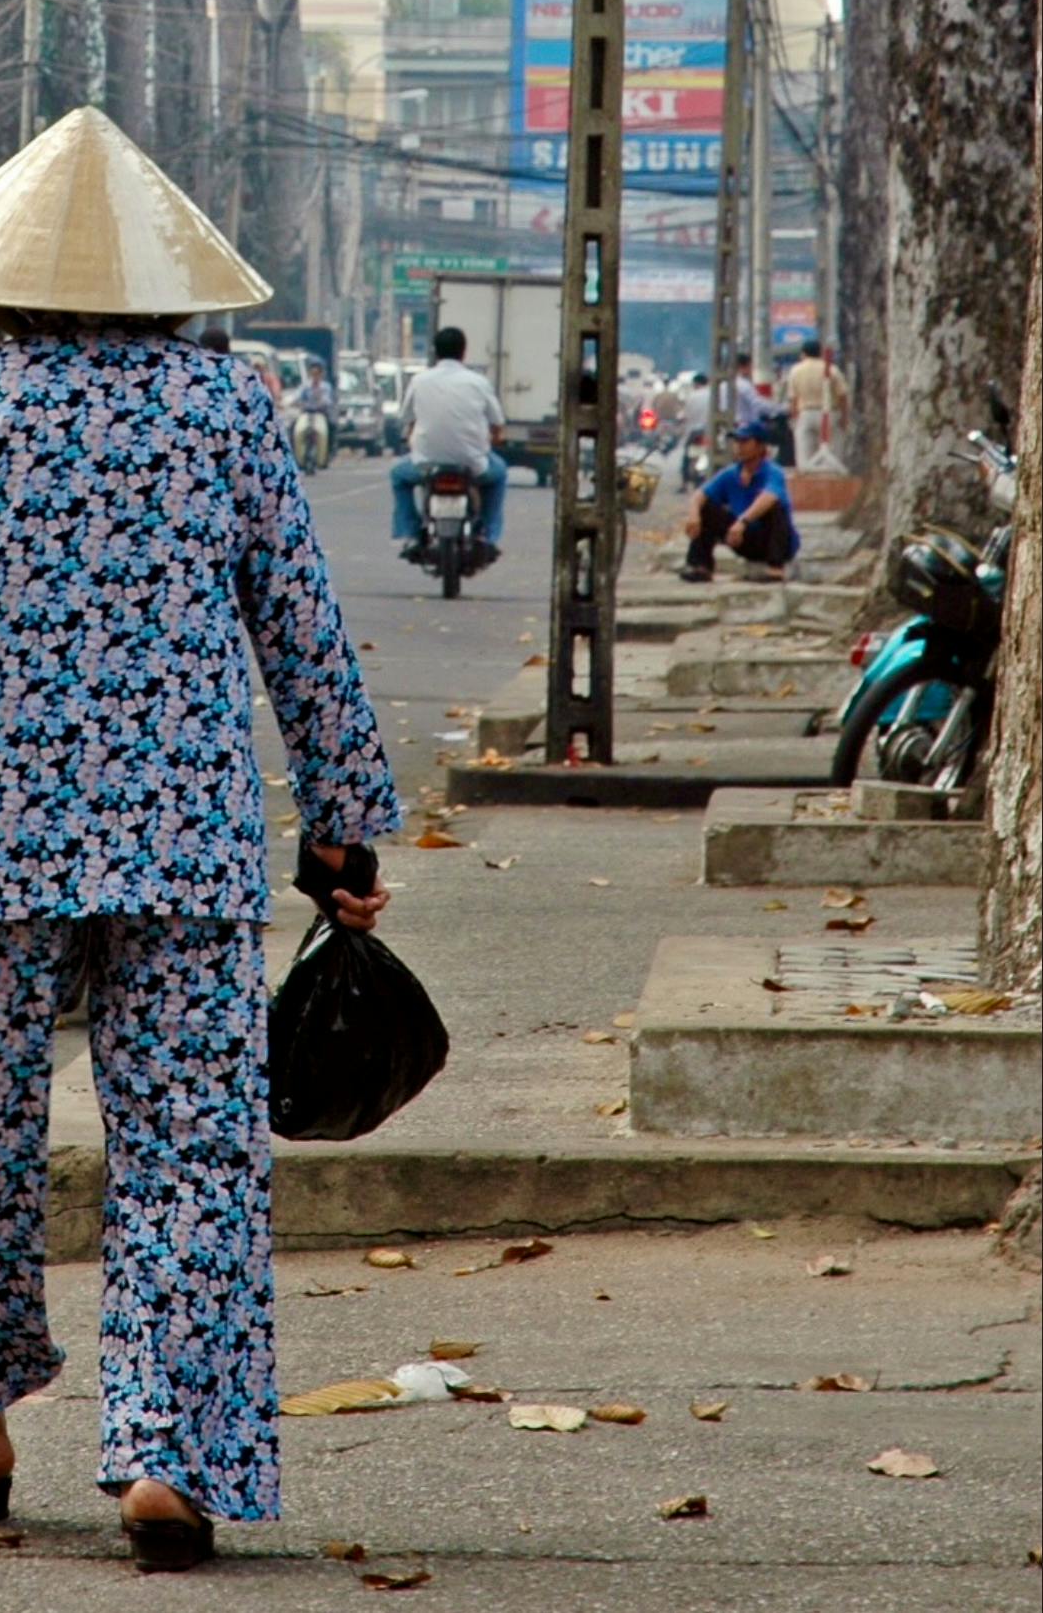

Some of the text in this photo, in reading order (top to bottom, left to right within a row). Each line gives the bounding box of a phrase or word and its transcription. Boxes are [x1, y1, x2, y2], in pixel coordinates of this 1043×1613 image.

[622, 3, 684, 19] UDIO
[623, 42, 686, 69] ther
[621, 88, 678, 121] KI
[531, 139, 723, 172] SSUNG
